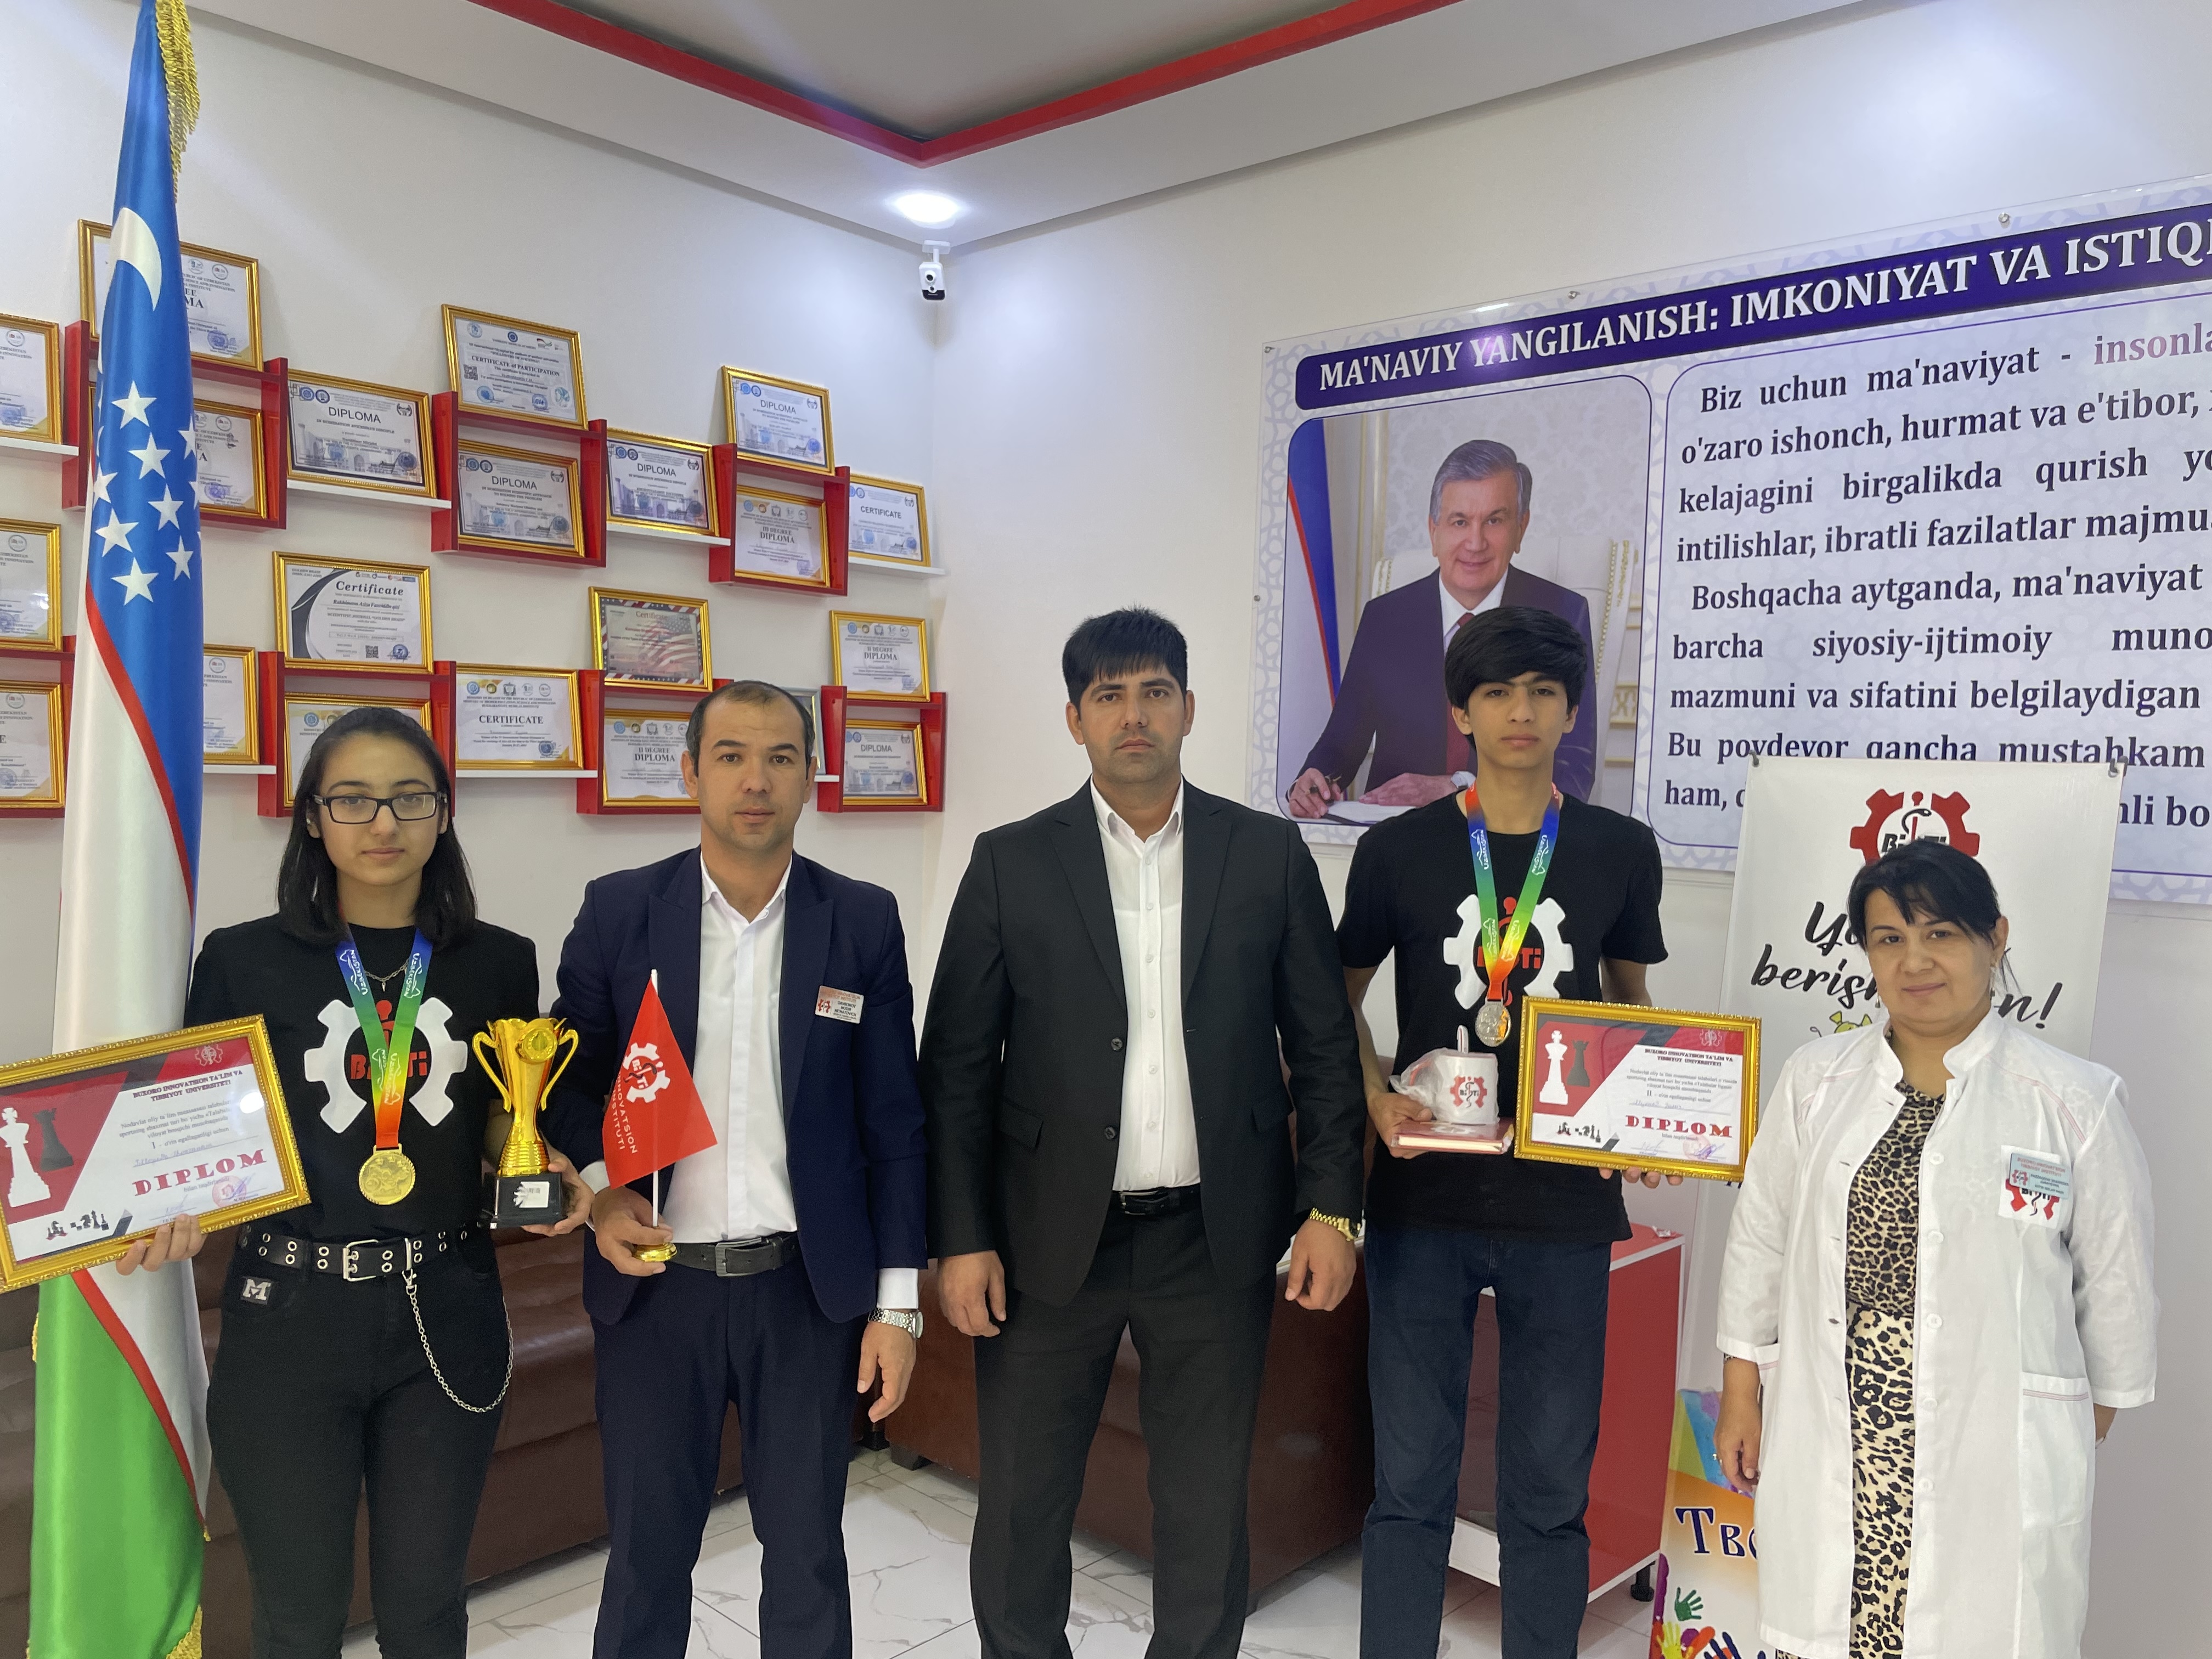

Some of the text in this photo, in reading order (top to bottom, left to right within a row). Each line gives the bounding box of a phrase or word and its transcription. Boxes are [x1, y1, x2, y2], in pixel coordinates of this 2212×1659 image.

[1319, 341, 1464, 391] MA'NAVIY
[1469, 301, 1719, 368] YANGILANISH:
[1730, 255, 1978, 328] IMKONIYAT
[1990, 244, 2051, 286] VA
[471, 356, 510, 367] CERTIFICATE
[517, 364, 560, 377] PARTICIPATION
[1700, 385, 1742, 414] Biz
[1759, 374, 1848, 406] uchun
[1866, 346, 2040, 393] ma'naviyat
[329, 407, 381, 424] DIPLOMA
[760, 399, 797, 414] DIPLOMA
[1681, 387, 2200, 465] o'zaro ishonch, hurmat va e'tibor,
[199, 453, 208, 461] A
[637, 463, 676, 477] DIPLOMA
[492, 476, 538, 490] DIPLOMA
[1678, 476, 1814, 515] kelajagini
[1842, 460, 2003, 504] birgalikda
[2036, 447, 2148, 491] qurish
[860, 505, 902, 519] CERTIFICATE
[760, 532, 795, 544] DIPLOMA
[1677, 504, 2212, 562] intilishlar, ibratli fazilatlar majmu
[336, 580, 404, 596] Certificate
[1691, 563, 2203, 617] Boshqacha aytganda, ma'naviyat
[636, 611, 668, 620] Certificate
[1673, 632, 1764, 660] barcha
[1812, 623, 2053, 663] siyosiy-ijtimoiy
[864, 652, 898, 661] DIPLOMA
[1670, 678, 2200, 717] mazmuni va sifatini belgilaydigan
[479, 715, 544, 724] CERTIFICATE
[635, 753, 675, 762] DIPLOMA
[1667, 732, 1702, 758] Bu
[1999, 736, 2205, 768] mustahkam
[1664, 779, 1728, 812] ham,
[1624, 1115, 1733, 1138] DIPLOM
[132, 1148, 267, 1197] DIPLOM
[243, 1279, 271, 1301] M
